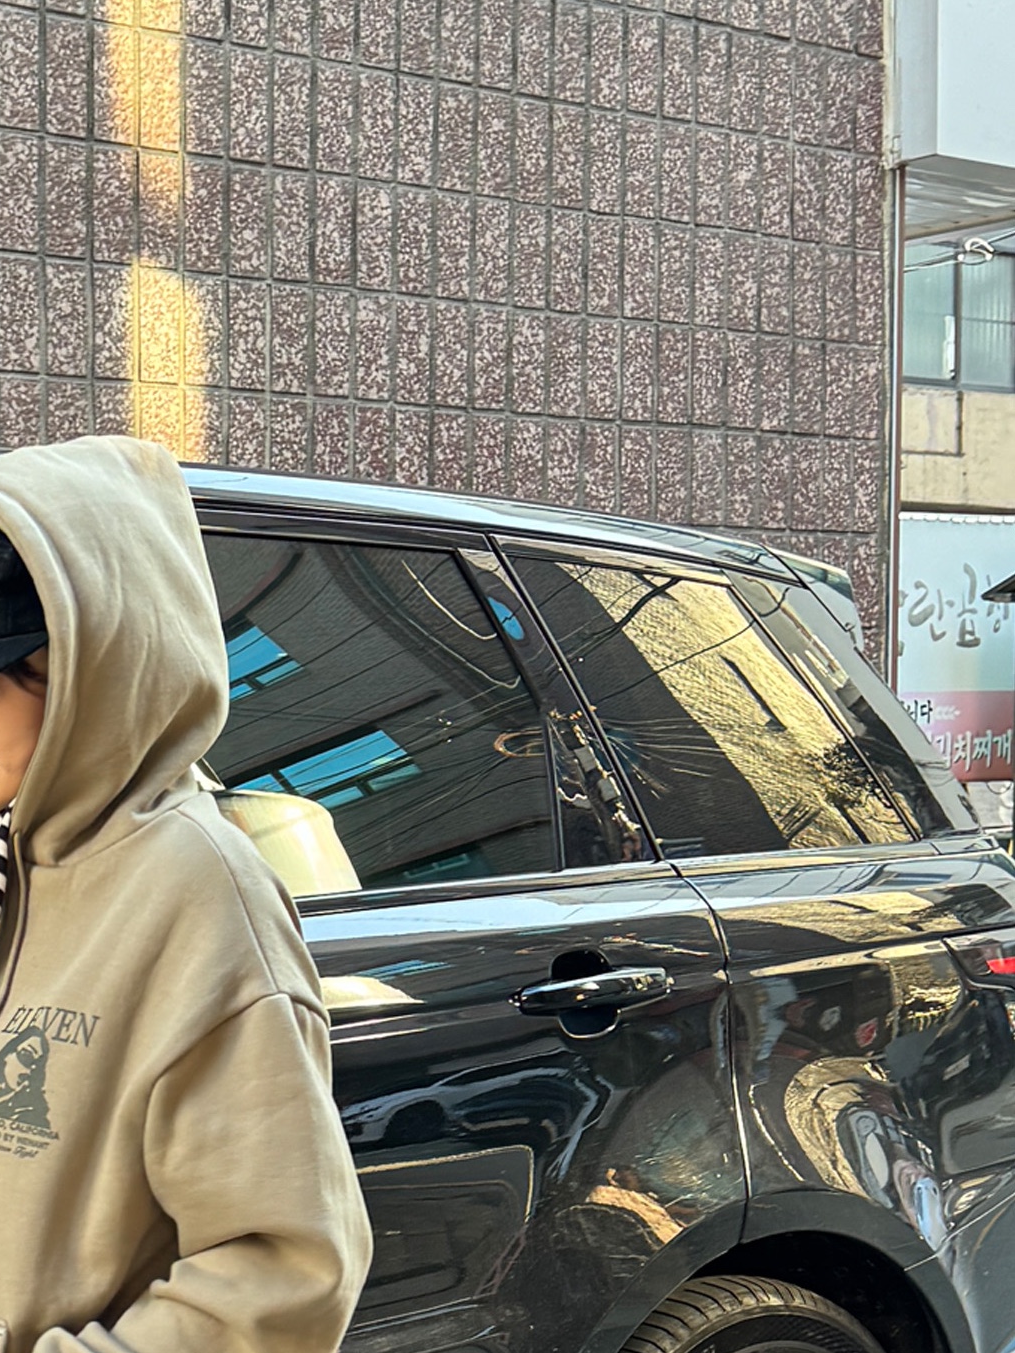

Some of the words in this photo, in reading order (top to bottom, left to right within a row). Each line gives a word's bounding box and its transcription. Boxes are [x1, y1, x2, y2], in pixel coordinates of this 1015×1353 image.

[928, 728, 1012, 772] 김치찌개
[1, 1004, 101, 1048] ELEVEN
[9, 1121, 60, 1140] CALIFORNIA
